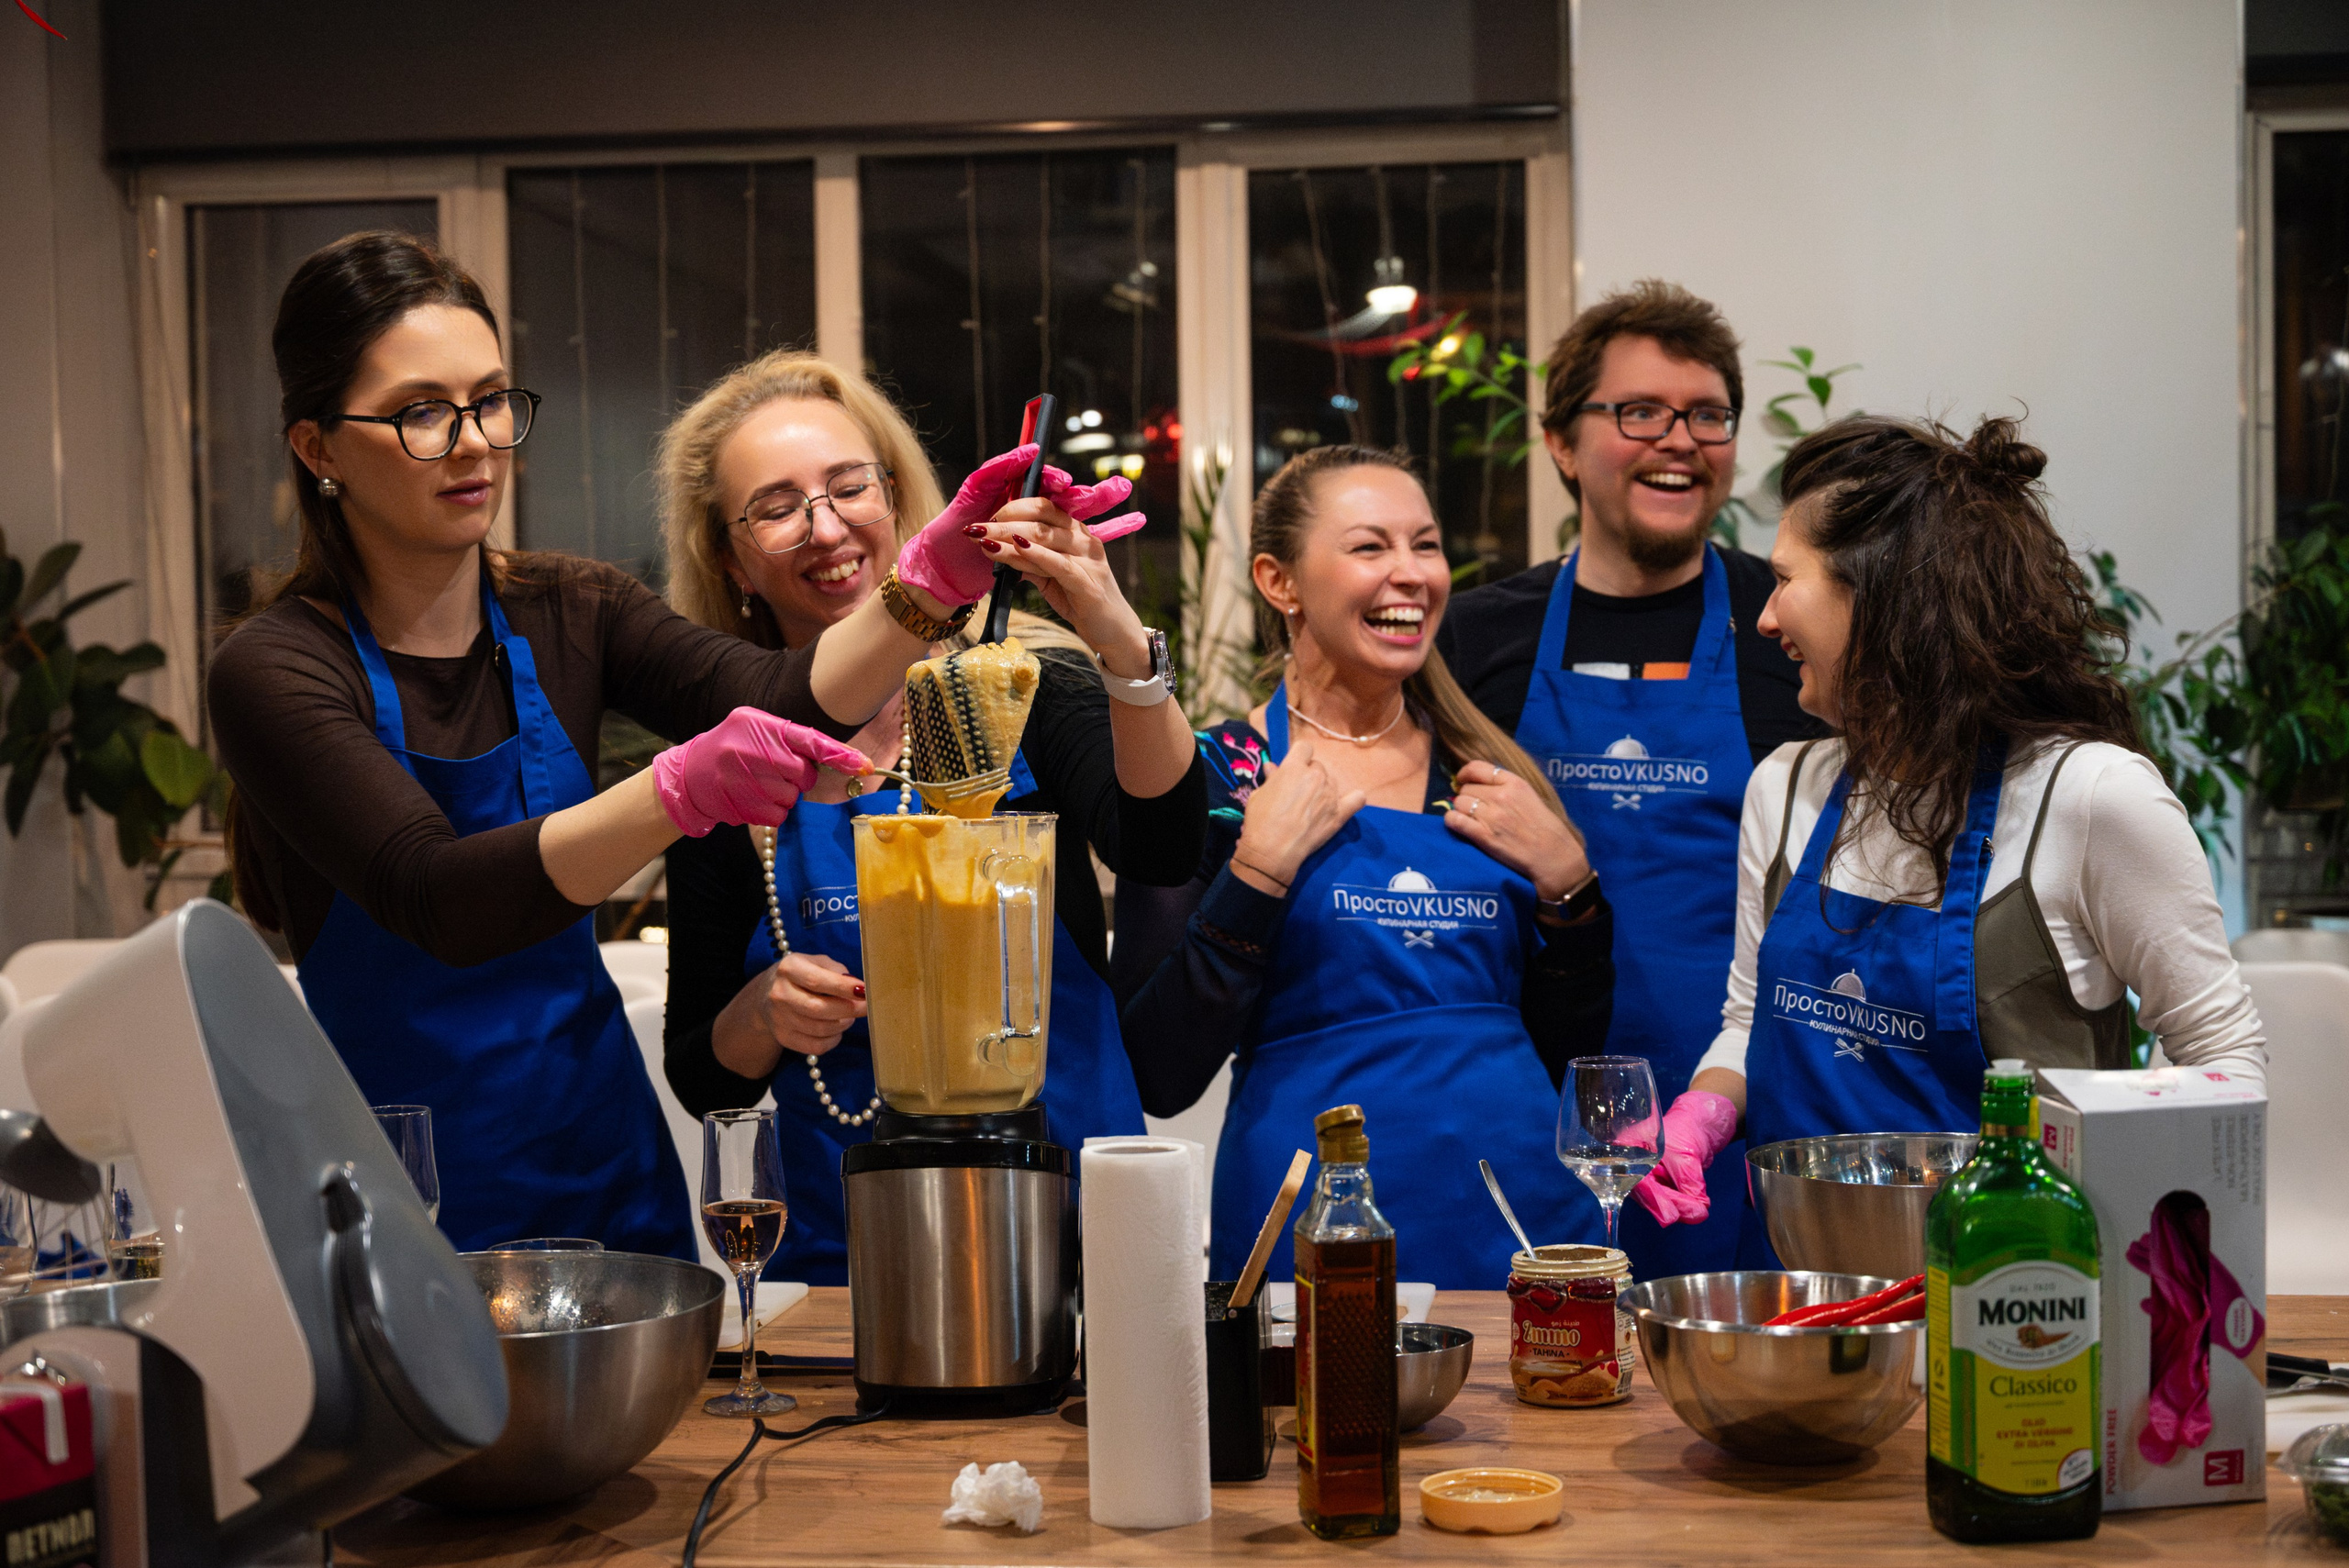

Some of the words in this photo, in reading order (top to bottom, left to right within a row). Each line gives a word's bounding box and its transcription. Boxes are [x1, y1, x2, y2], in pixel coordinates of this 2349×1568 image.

[1333, 889, 1499, 918] ПростоVKUSNO
[1774, 984, 1926, 1040] ПростоVKUSNO
[1978, 1296, 2086, 1326] MONINI
[1532, 1348, 1565, 1358] TAHINA
[1989, 1373, 2077, 1397] Classico
